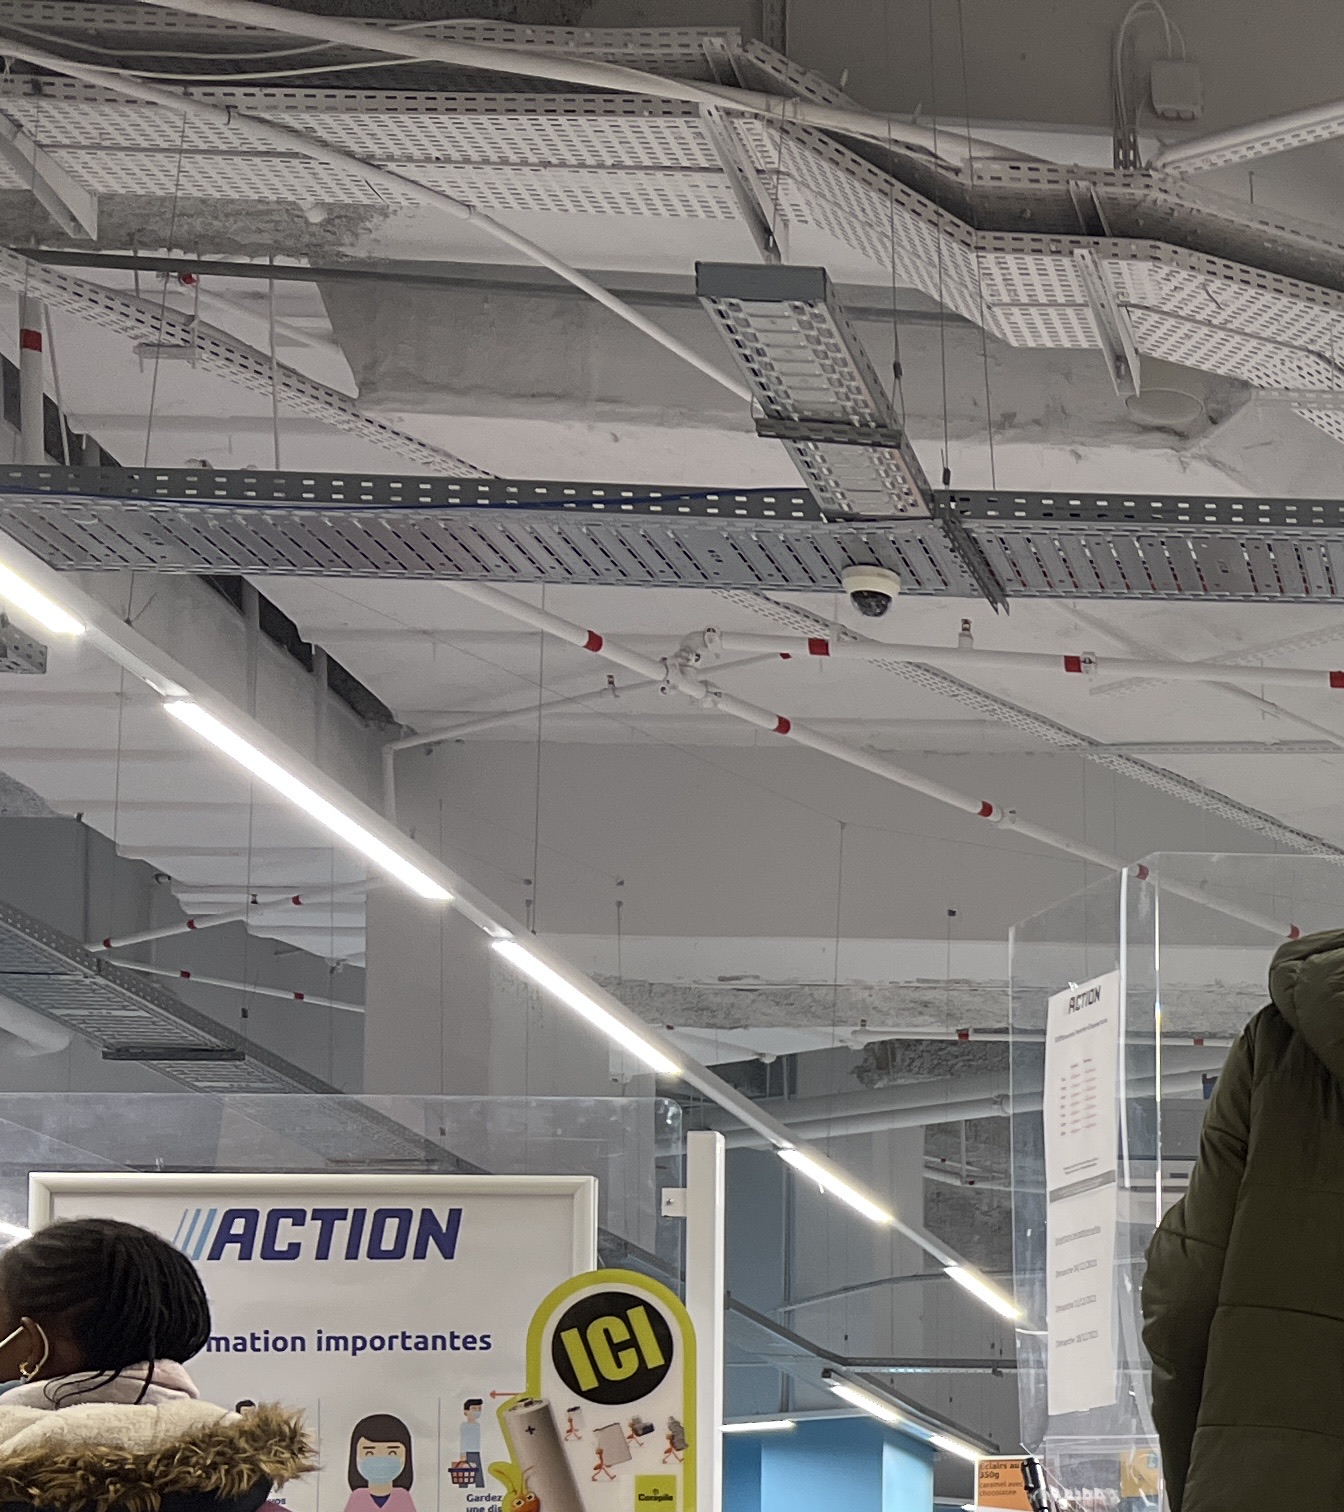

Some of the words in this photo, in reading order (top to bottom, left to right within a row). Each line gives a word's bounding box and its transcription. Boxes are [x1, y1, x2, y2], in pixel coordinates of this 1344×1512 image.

[1068, 986, 1101, 1014] ACTION
[207, 1208, 462, 1260] ACTION
[204, 1330, 306, 1352] mation
[316, 1330, 492, 1356] importantes
[560, 1305, 665, 1392] ICI
[466, 1493, 502, 1502] Gardez
[488, 1504, 502, 1512] dis
